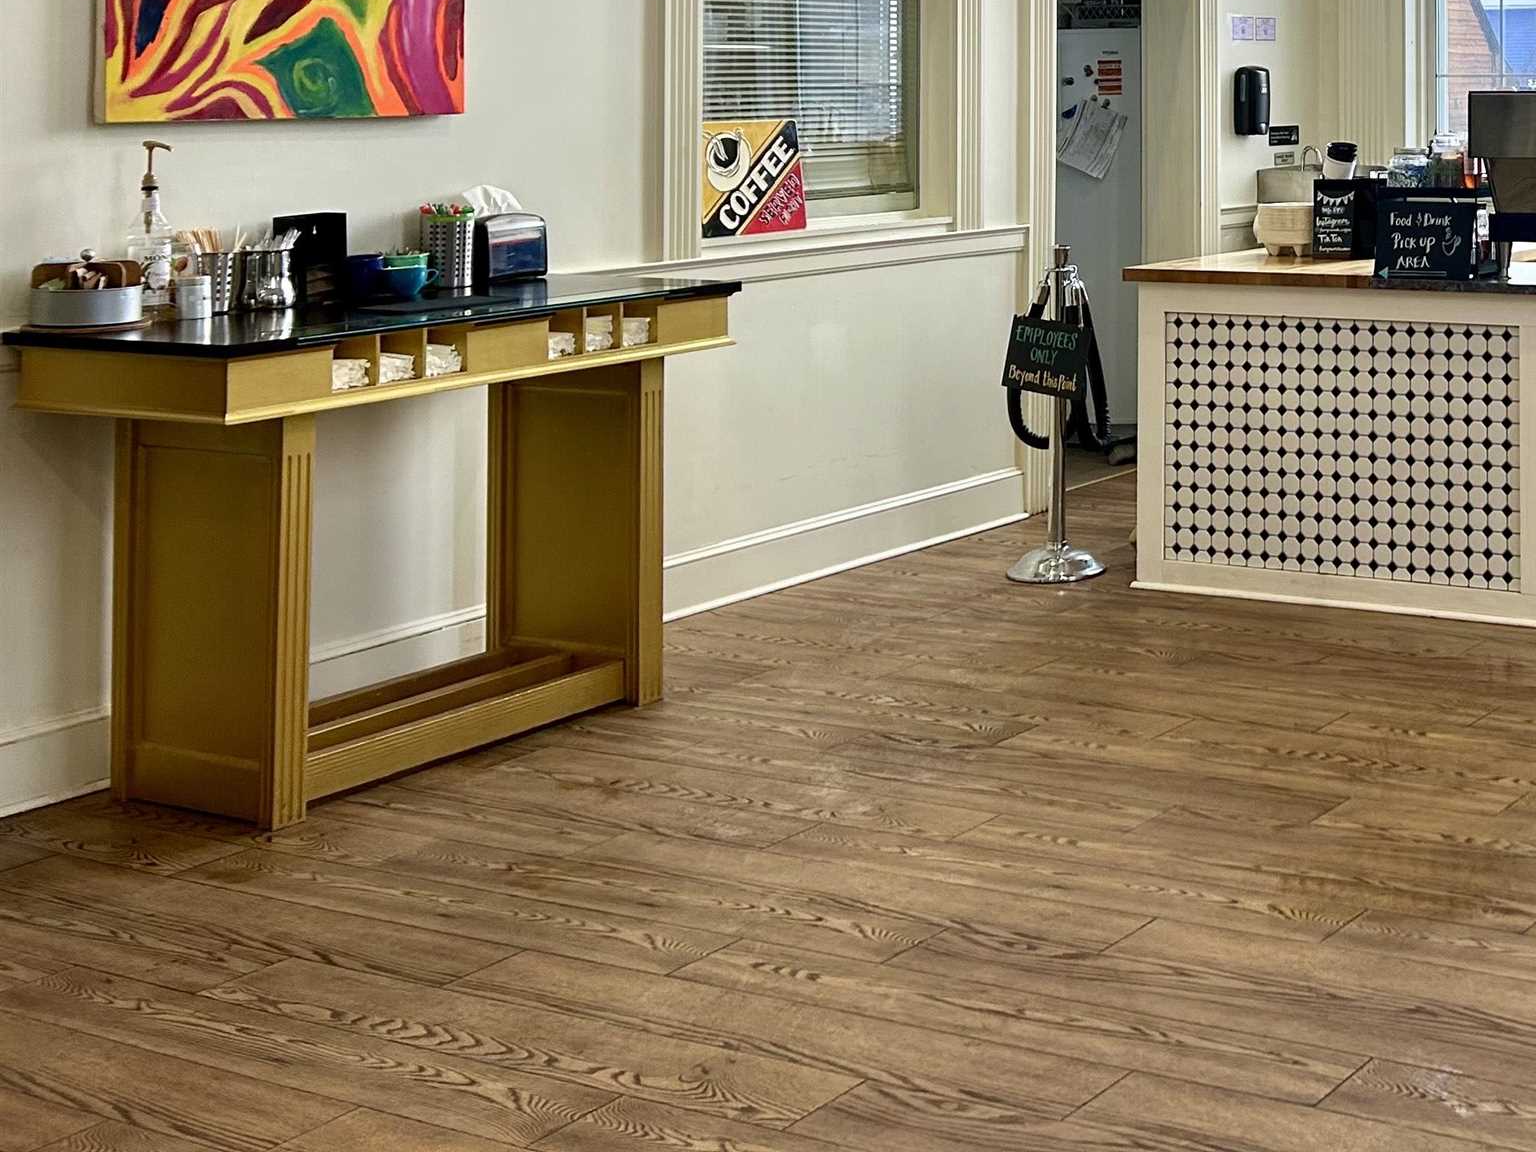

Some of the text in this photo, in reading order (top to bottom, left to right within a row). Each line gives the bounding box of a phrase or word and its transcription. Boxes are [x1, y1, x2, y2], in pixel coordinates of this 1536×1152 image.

[719, 136, 794, 230] COFFEE
[1390, 212, 1412, 227] Food
[1424, 213, 1452, 227] Drink
[1396, 256, 1430, 270] AREA
[1016, 325, 1079, 351] EMPLOYEES
[1030, 348, 1058, 364] ONLY
[1008, 364, 1040, 386] Beyond
[1057, 373, 1078, 392] Point
